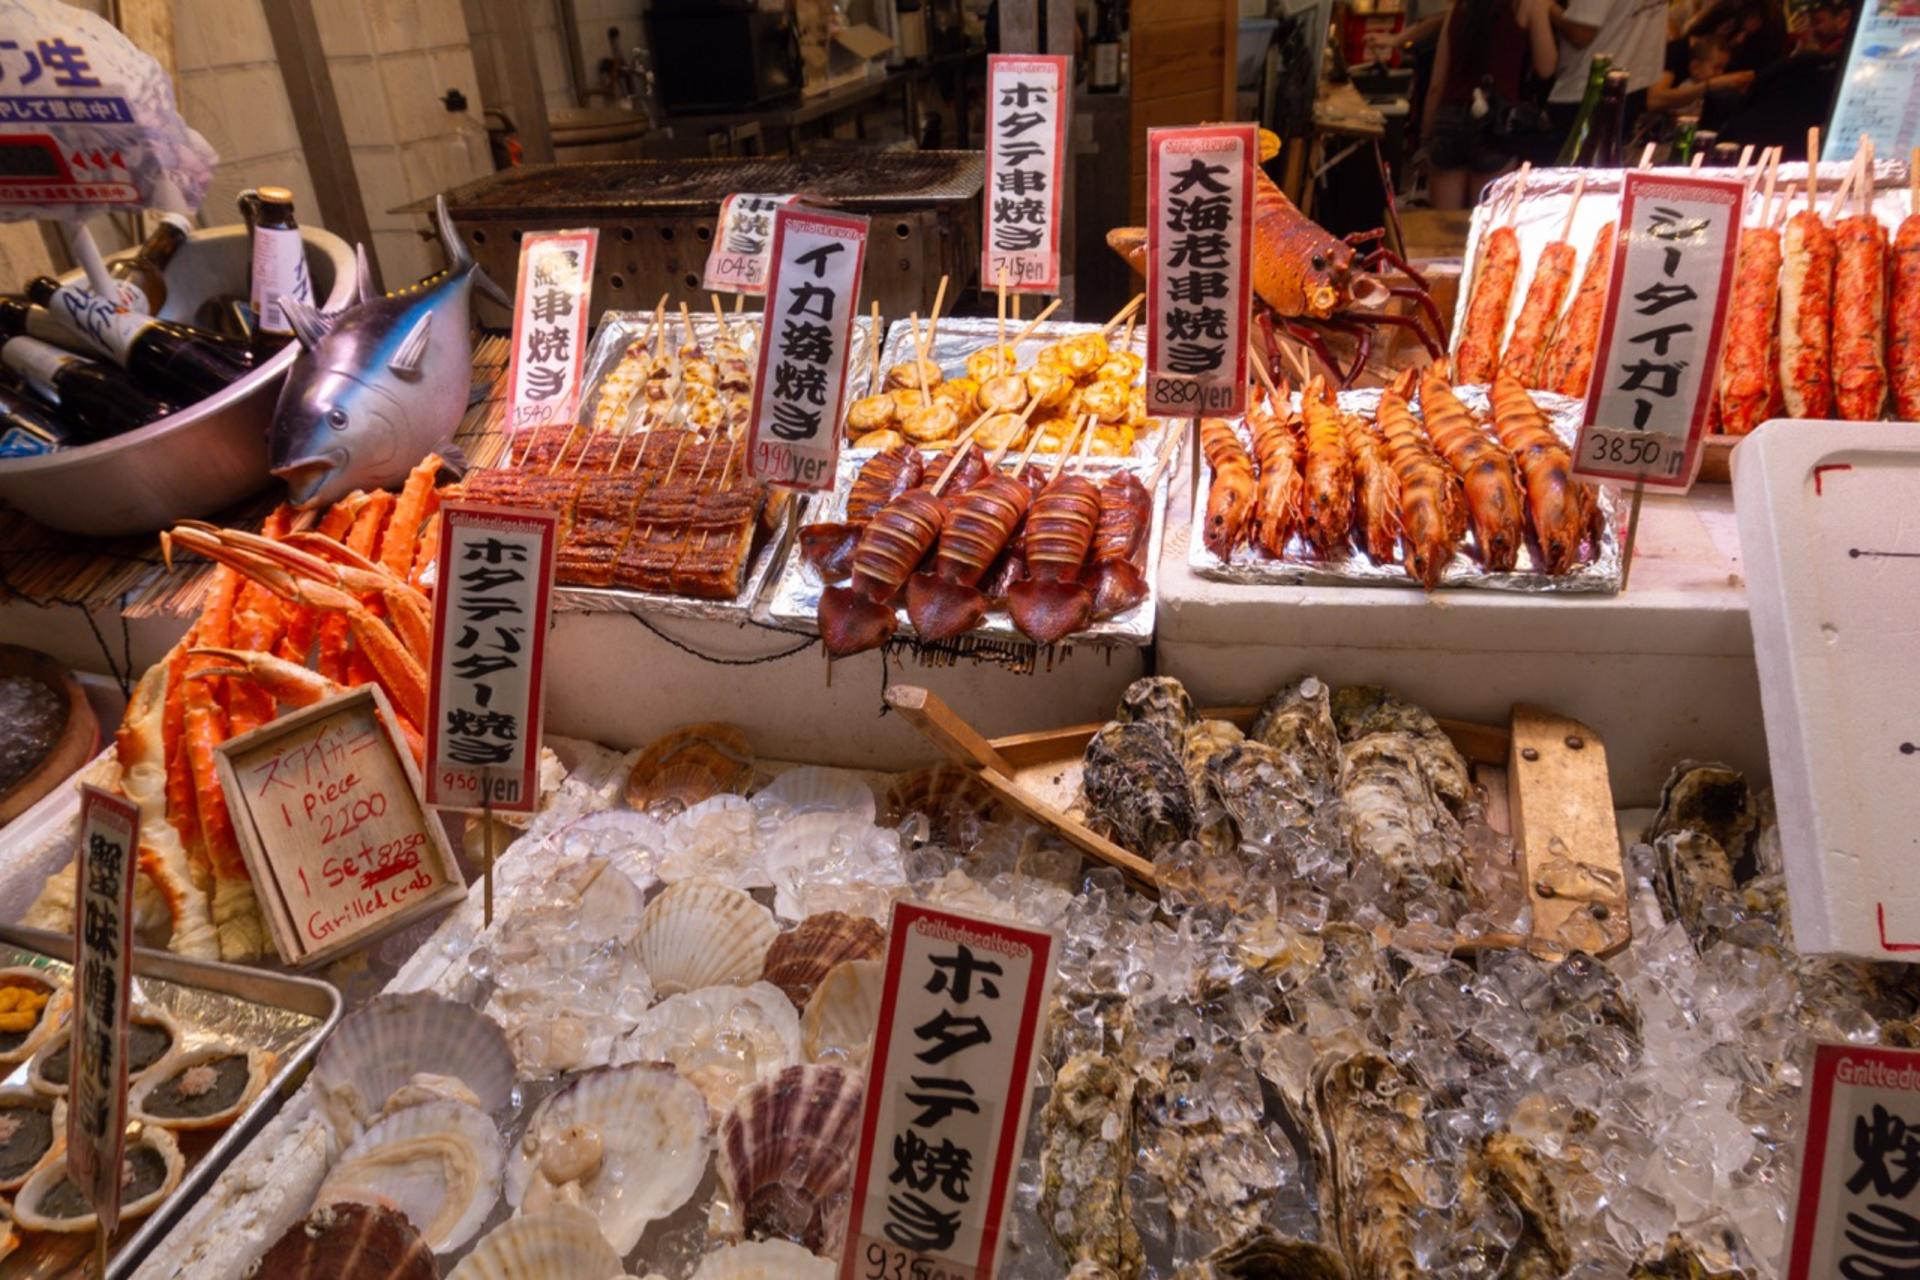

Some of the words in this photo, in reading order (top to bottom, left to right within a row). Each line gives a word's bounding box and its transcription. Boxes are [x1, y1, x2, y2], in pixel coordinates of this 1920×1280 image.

[0, 38, 101, 87] ン生
[994, 82, 1047, 251] ホタテ串焼き
[1166, 159, 1233, 374] 大海老串焼き
[1618, 206, 1711, 431] シータイガー
[770, 242, 845, 440] イカ姿焼き
[1155, 379, 1200, 404] 880
[1591, 433, 1661, 465] 3850
[446, 538, 528, 765] ホタテバター焼き
[320, 792, 387, 845] 2200
[481, 775, 519, 807] yen
[307, 889, 389, 940] Grilled
[883, 944, 1004, 1251] ホタテ焼き
